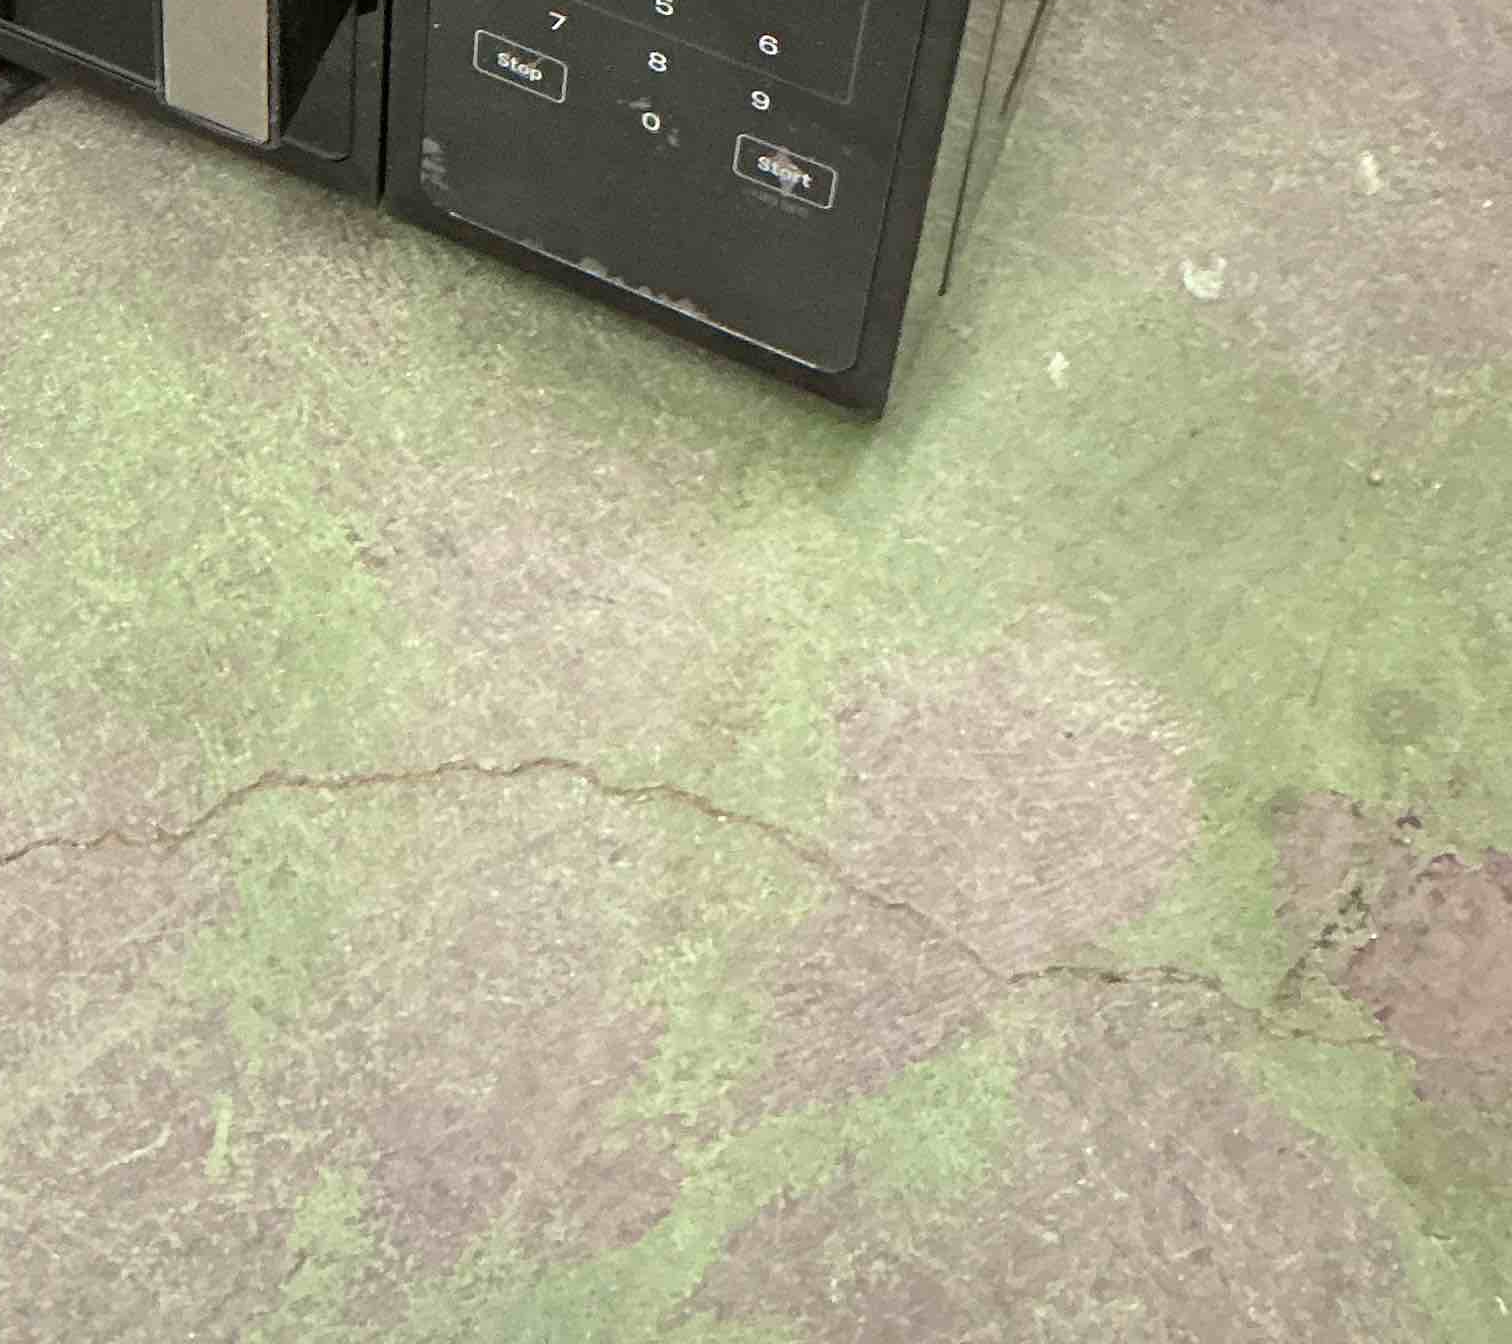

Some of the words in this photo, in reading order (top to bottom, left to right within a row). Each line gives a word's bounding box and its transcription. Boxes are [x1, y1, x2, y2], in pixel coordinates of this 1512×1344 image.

[548, 11, 567, 31] 7
[758, 34, 779, 56] 6
[496, 52, 543, 82] Stop
[647, 51, 668, 72] 8
[751, 90, 771, 111] 9
[641, 112, 661, 132] 0
[757, 155, 814, 189] Start
